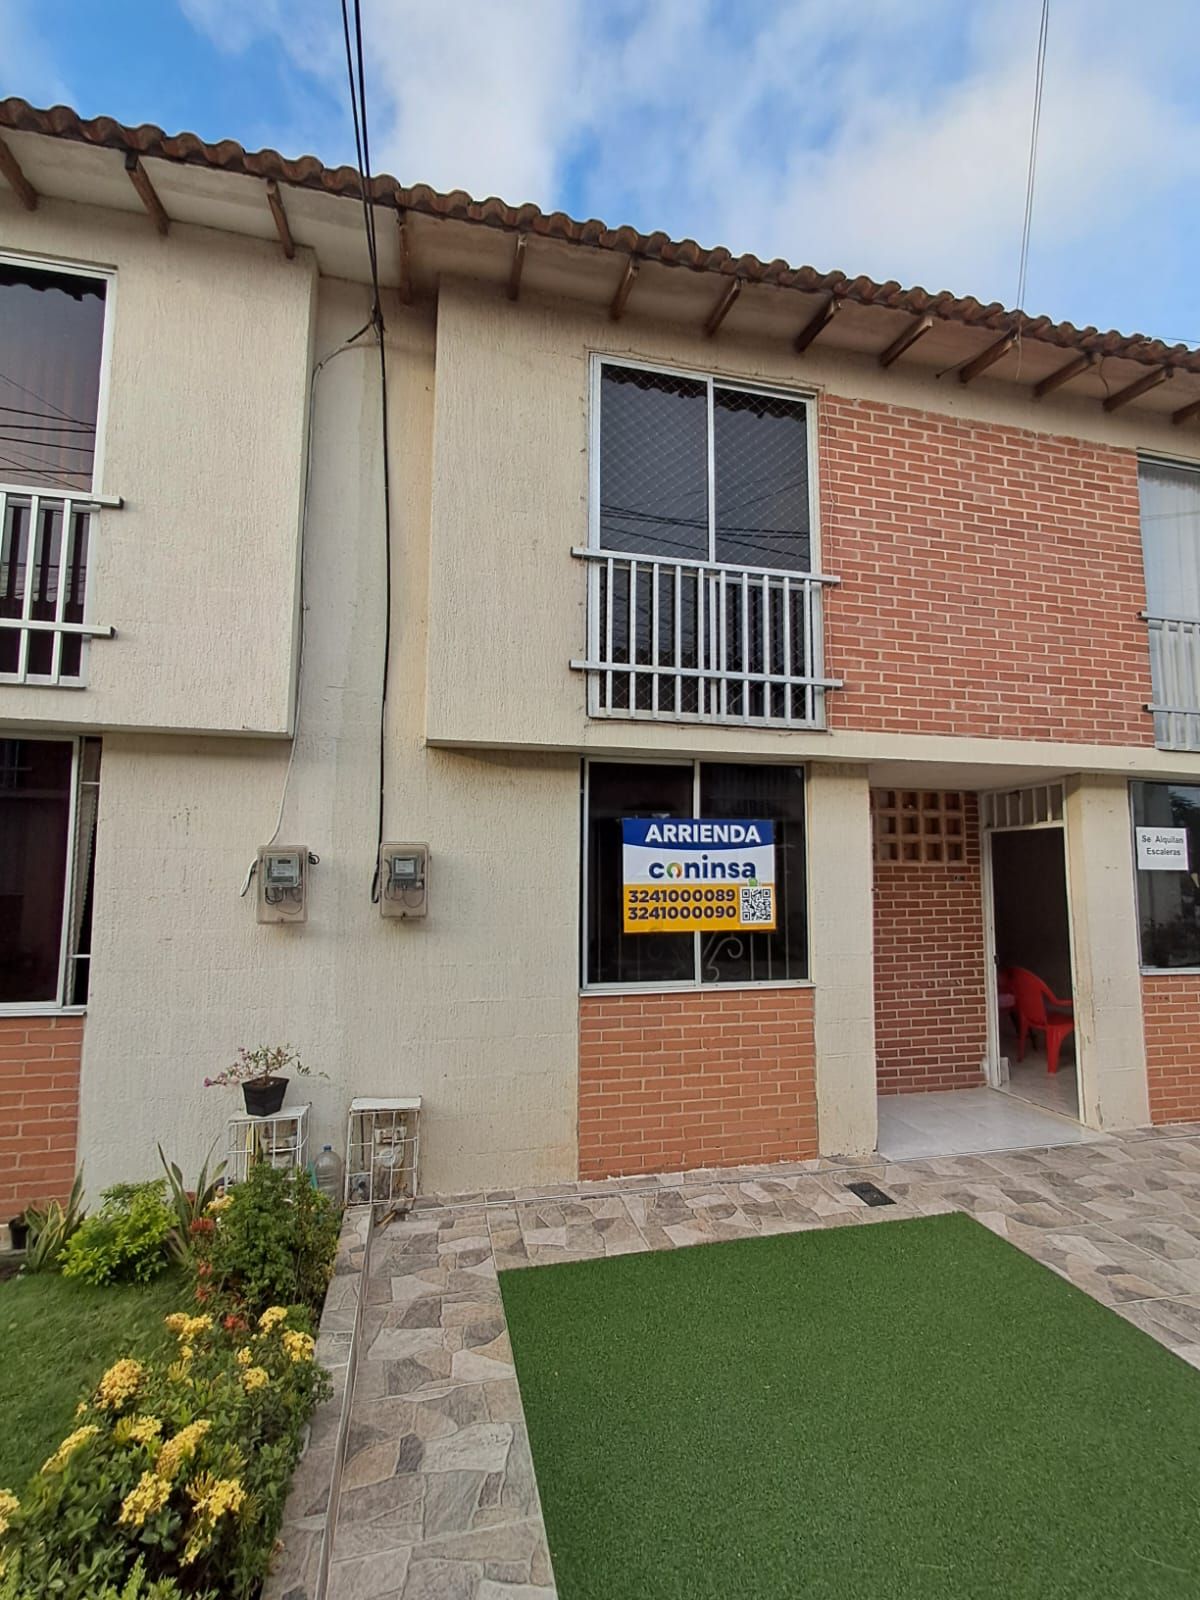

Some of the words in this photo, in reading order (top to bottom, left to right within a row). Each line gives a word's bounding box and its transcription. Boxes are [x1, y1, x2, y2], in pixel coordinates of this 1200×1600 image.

[645, 824, 761, 843] ARRIENDA
[1141, 835, 1151, 843] Se
[1146, 847, 1181, 856] Escaleras
[649, 854, 757, 879] coninsa
[628, 889, 736, 903] 3241000089
[628, 905, 737, 920] 3241000090
